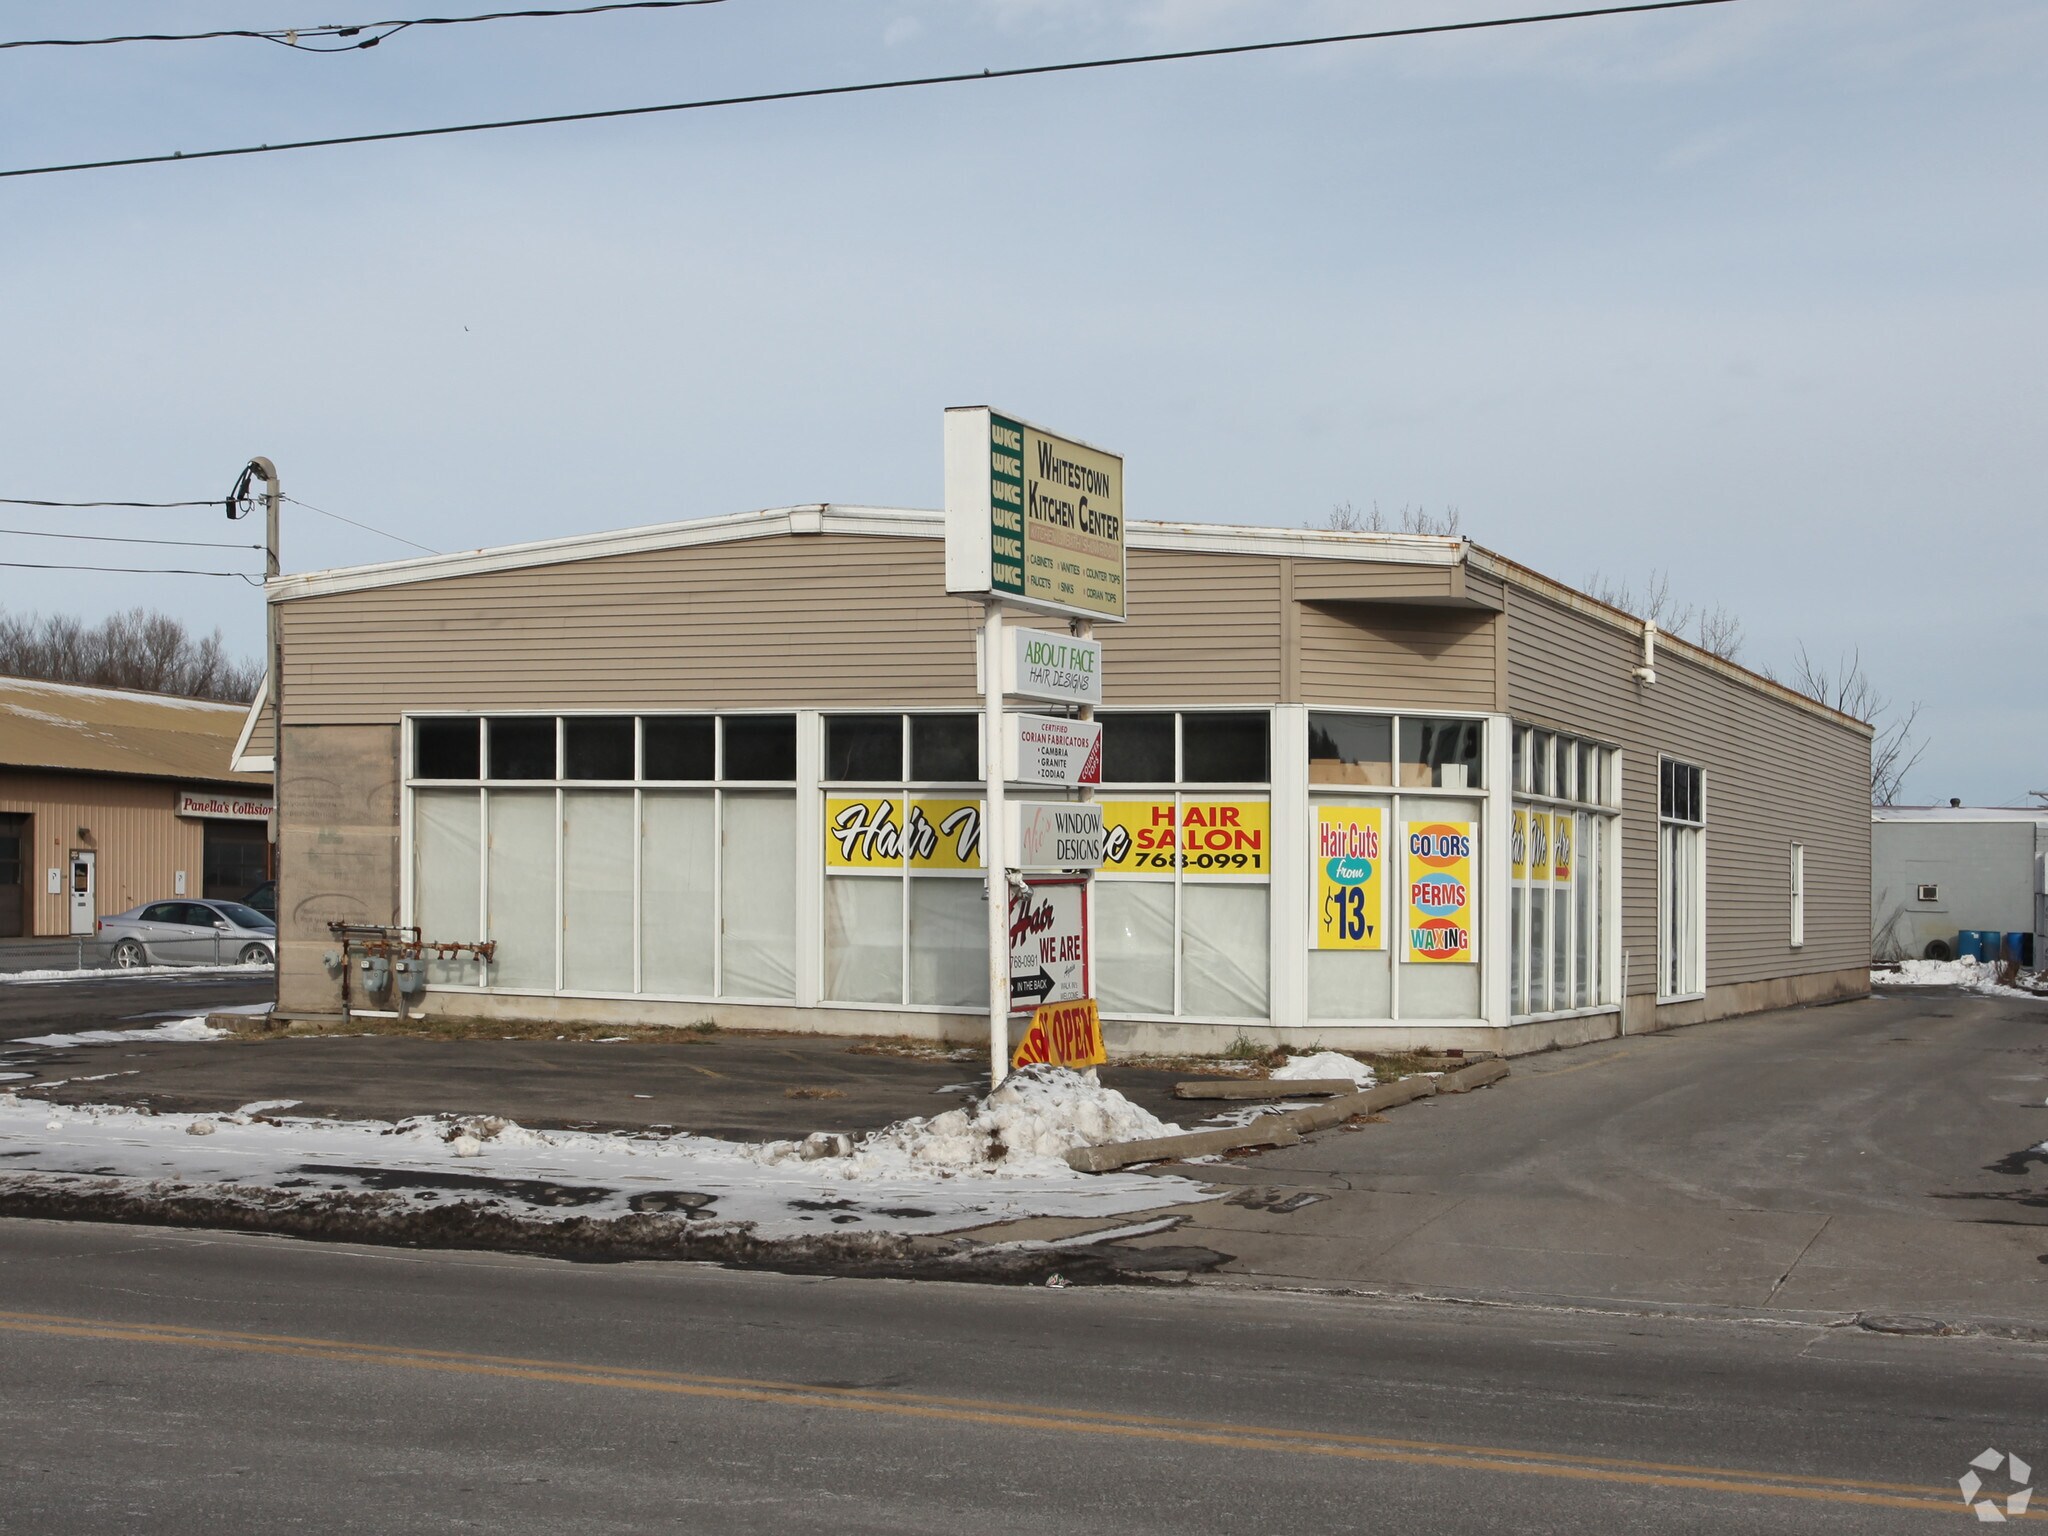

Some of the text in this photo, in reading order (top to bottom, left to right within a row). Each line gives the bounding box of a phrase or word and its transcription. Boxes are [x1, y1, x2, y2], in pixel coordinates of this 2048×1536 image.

[992, 424, 1021, 451] WKC
[992, 451, 1021, 478] WKC
[1037, 439, 1110, 499] WHITESTOWN
[992, 479, 1021, 505] WKC
[992, 506, 1021, 532] WKC
[1028, 479, 1119, 541] KITCHEN CENTER
[992, 534, 1021, 560] WKC
[992, 562, 1021, 586] WKC
[1030, 554, 1120, 585] CABINETS VANITIES COUNTER TOPS
[1031, 575, 1116, 603] FAUCETS SINKS CORIAN TOPS
[1025, 640, 1095, 673] ABOUT FACE
[1029, 667, 1089, 693] HAIR DESIGNS
[1021, 731, 1089, 748] CORIAN FABRICATORS
[1041, 723, 1068, 733] CERTIFIED
[1041, 747, 1068, 757] CAMBRIA
[1041, 758, 1067, 768] GRANITE
[1081, 740, 1099, 780] COUNTER
[1041, 769, 1065, 779] ZODIAQ
[1089, 755, 1099, 779] TOPS
[183, 797, 230, 814] Panella's
[1152, 806, 1241, 827] HAIR
[831, 799, 938, 861] Hair
[1055, 812, 1100, 834] WINDOW
[1057, 839, 1099, 860] DESIGNS
[1137, 829, 1261, 850] SALON
[1320, 822, 1378, 858] Hair Cuts
[1410, 833, 1470, 857] COLORS
[1135, 853, 1260, 868] 768-0991
[1336, 859, 1364, 878] from
[1411, 883, 1466, 907] PERMS
[1010, 896, 1055, 950] Hair
[1040, 935, 1080, 964] WE ARE
[1410, 928, 1468, 950] WAXING
[1011, 954, 1038, 969] 768-0991
[1017, 982, 1023, 991] IN
[1023, 981, 1033, 991] THE
[1033, 979, 1047, 990] BACK
[1060, 991, 1079, 1000] WELCOME
[1053, 1006, 1095, 1064] OPEN
